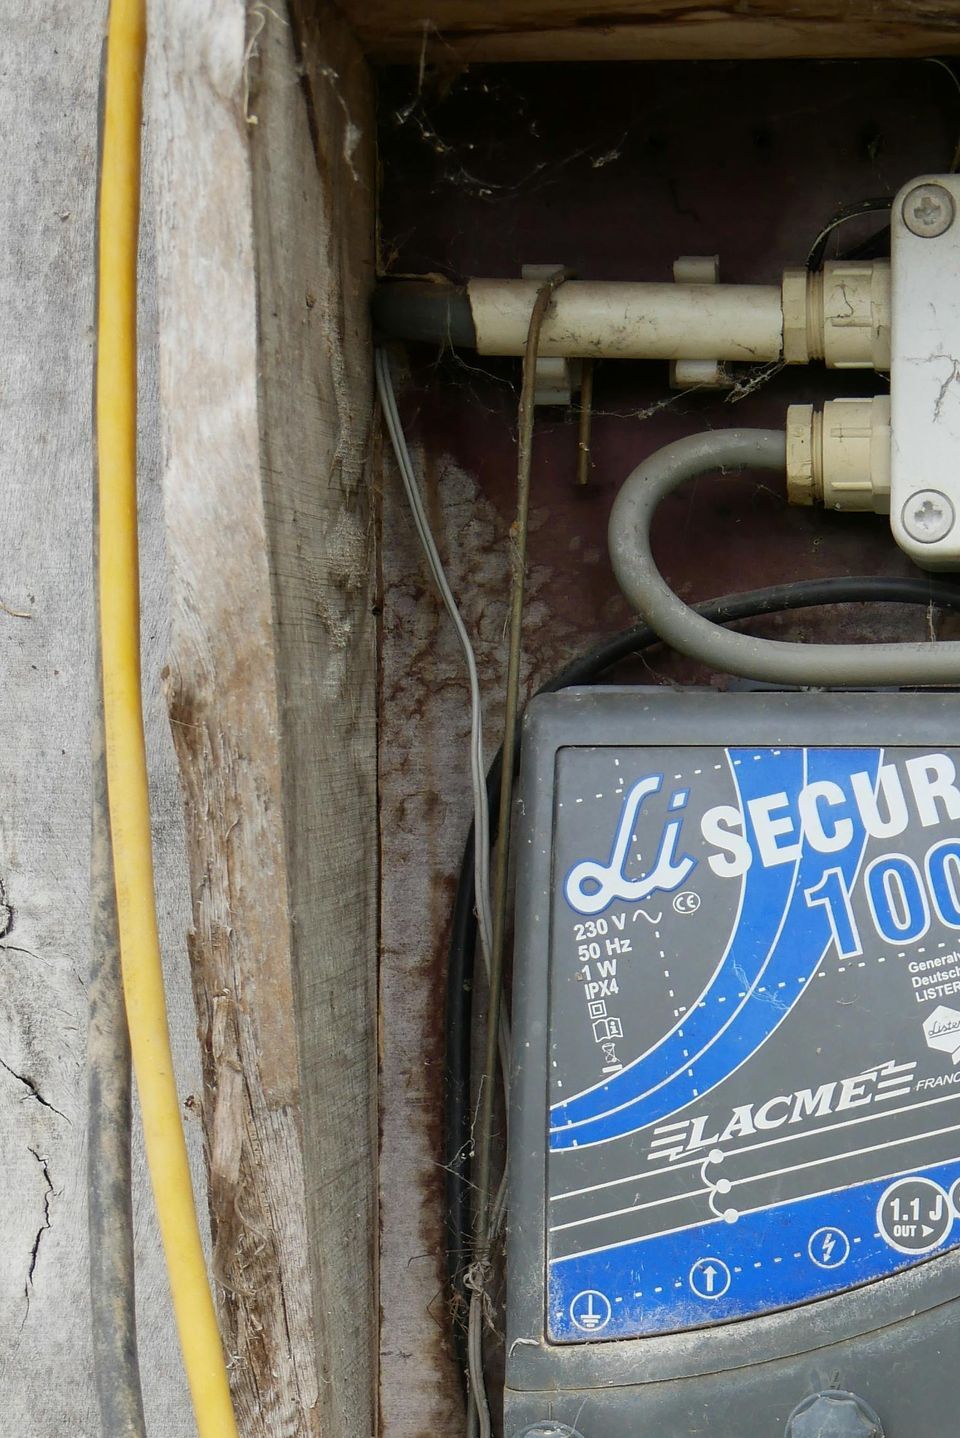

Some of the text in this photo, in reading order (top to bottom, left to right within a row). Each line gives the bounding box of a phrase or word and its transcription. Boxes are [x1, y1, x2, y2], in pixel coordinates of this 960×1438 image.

[574, 913, 626, 940] 230 V
[579, 938, 632, 961] 50 Hz
[581, 960, 617, 980] 1 W
[585, 979, 618, 1000] IPX4
[685, 1071, 878, 1151] LACME
[891, 1195, 942, 1220] 1.1 J
[894, 1225, 916, 1236] OUT
